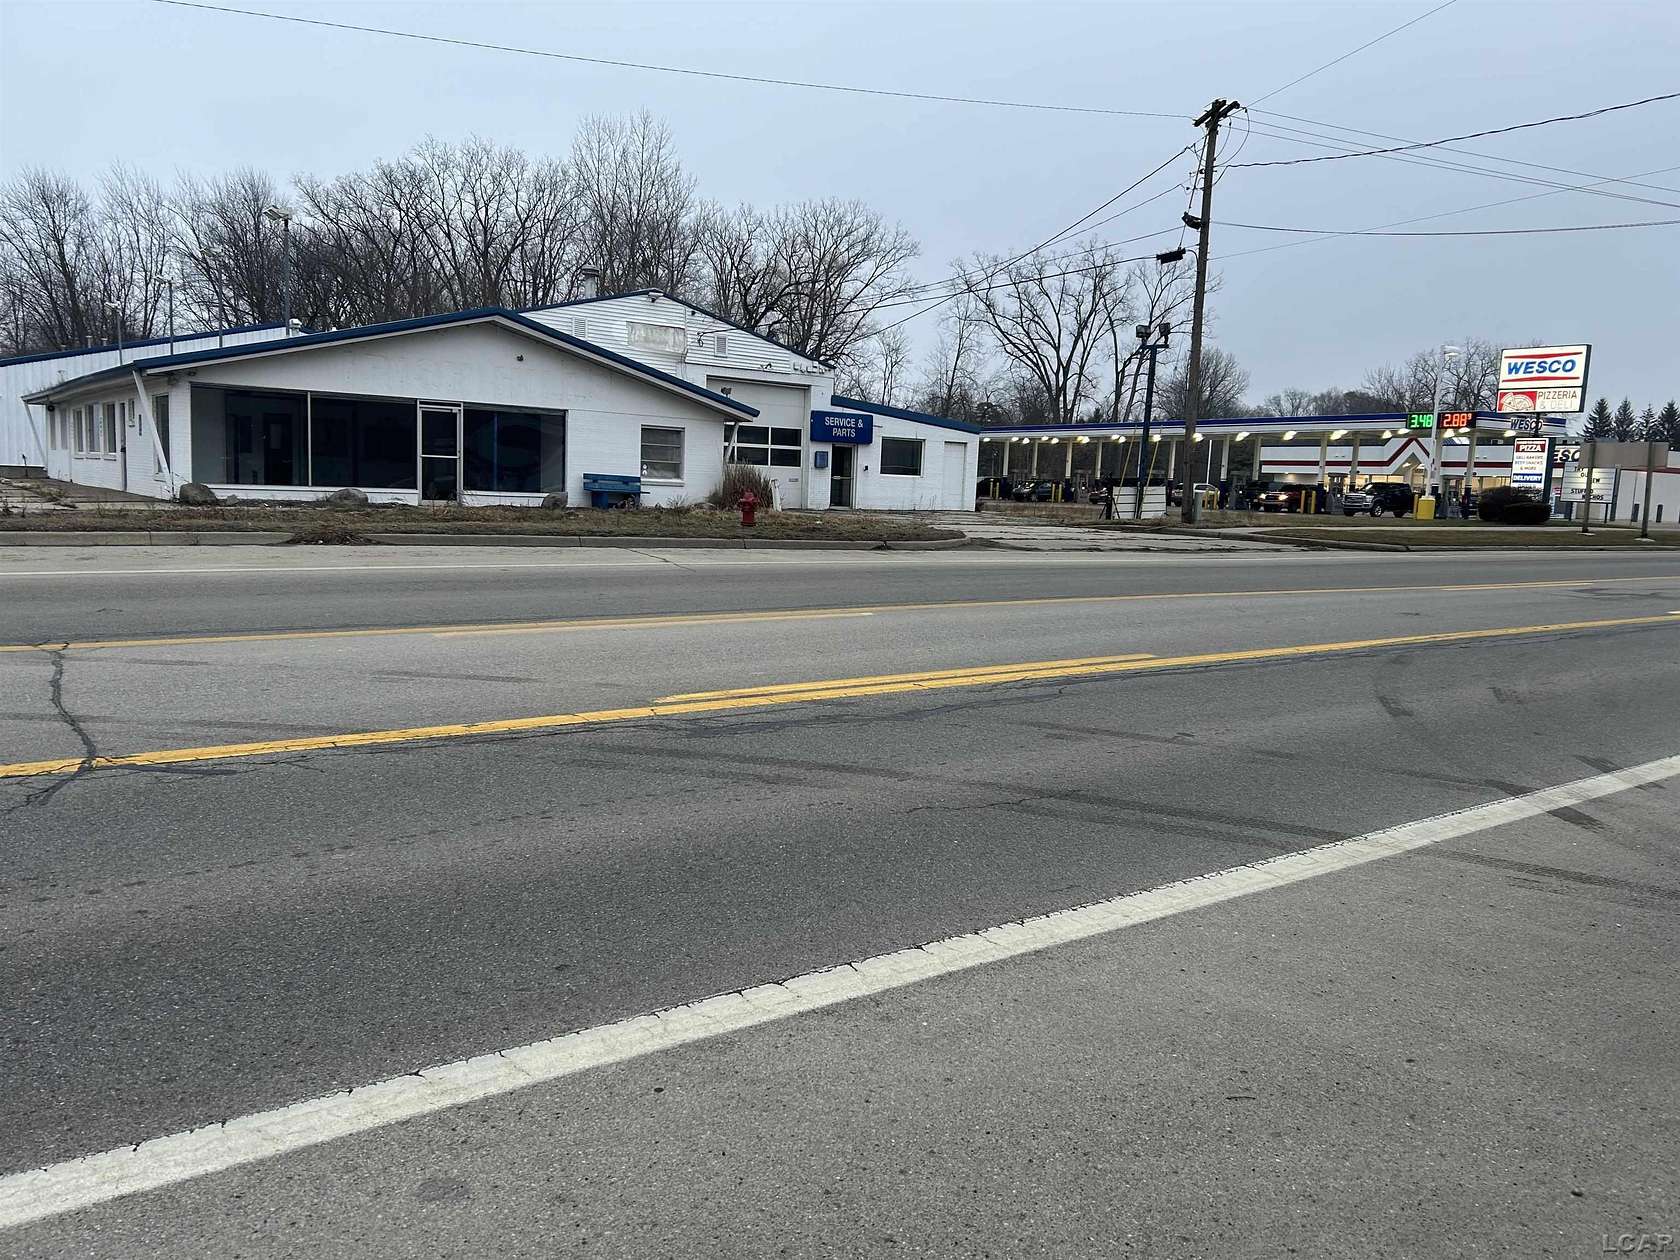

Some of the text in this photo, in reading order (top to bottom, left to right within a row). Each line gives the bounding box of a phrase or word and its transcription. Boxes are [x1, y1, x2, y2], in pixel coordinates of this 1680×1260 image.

[1507, 359, 1576, 375] WESCO
[1538, 390, 1577, 400] PIZZERIA
[1539, 400, 1573, 410] & DELI
[824, 416, 864, 428] SERVICE &
[1410, 414, 1433, 428] 3.48
[832, 428, 856, 438] PARTS
